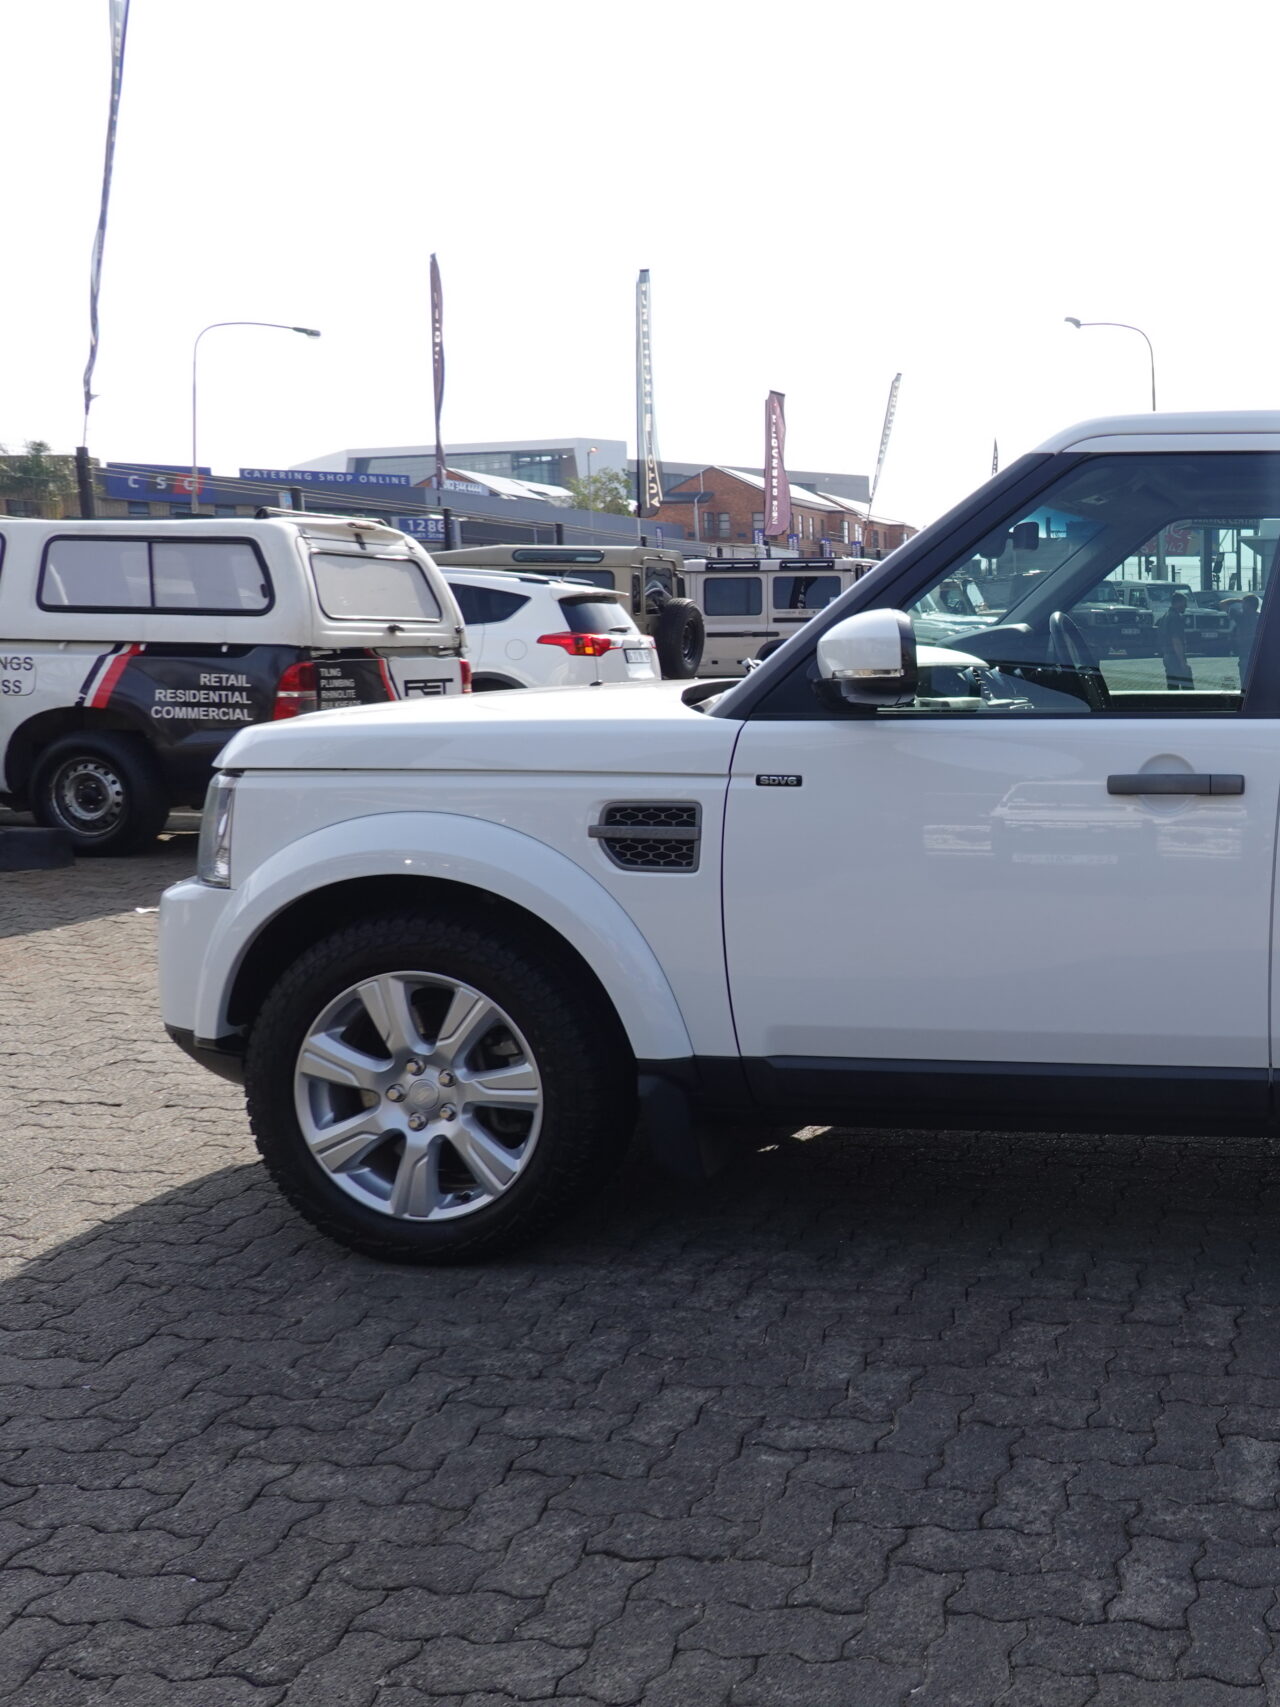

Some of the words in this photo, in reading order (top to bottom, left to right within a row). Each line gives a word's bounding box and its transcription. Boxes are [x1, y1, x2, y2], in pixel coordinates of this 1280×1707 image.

[244, 469, 313, 481] CATERING
[319, 473, 353, 482] SHOP
[359, 475, 408, 485] ONLINE
[646, 453, 661, 508] AUTO
[407, 519, 446, 532] 1286
[200, 673, 252, 687] RETAIL
[154, 689, 253, 704] RESIDENTIAL
[150, 706, 254, 721] COMMERCIAL
[759, 775, 797, 786] SDV6
